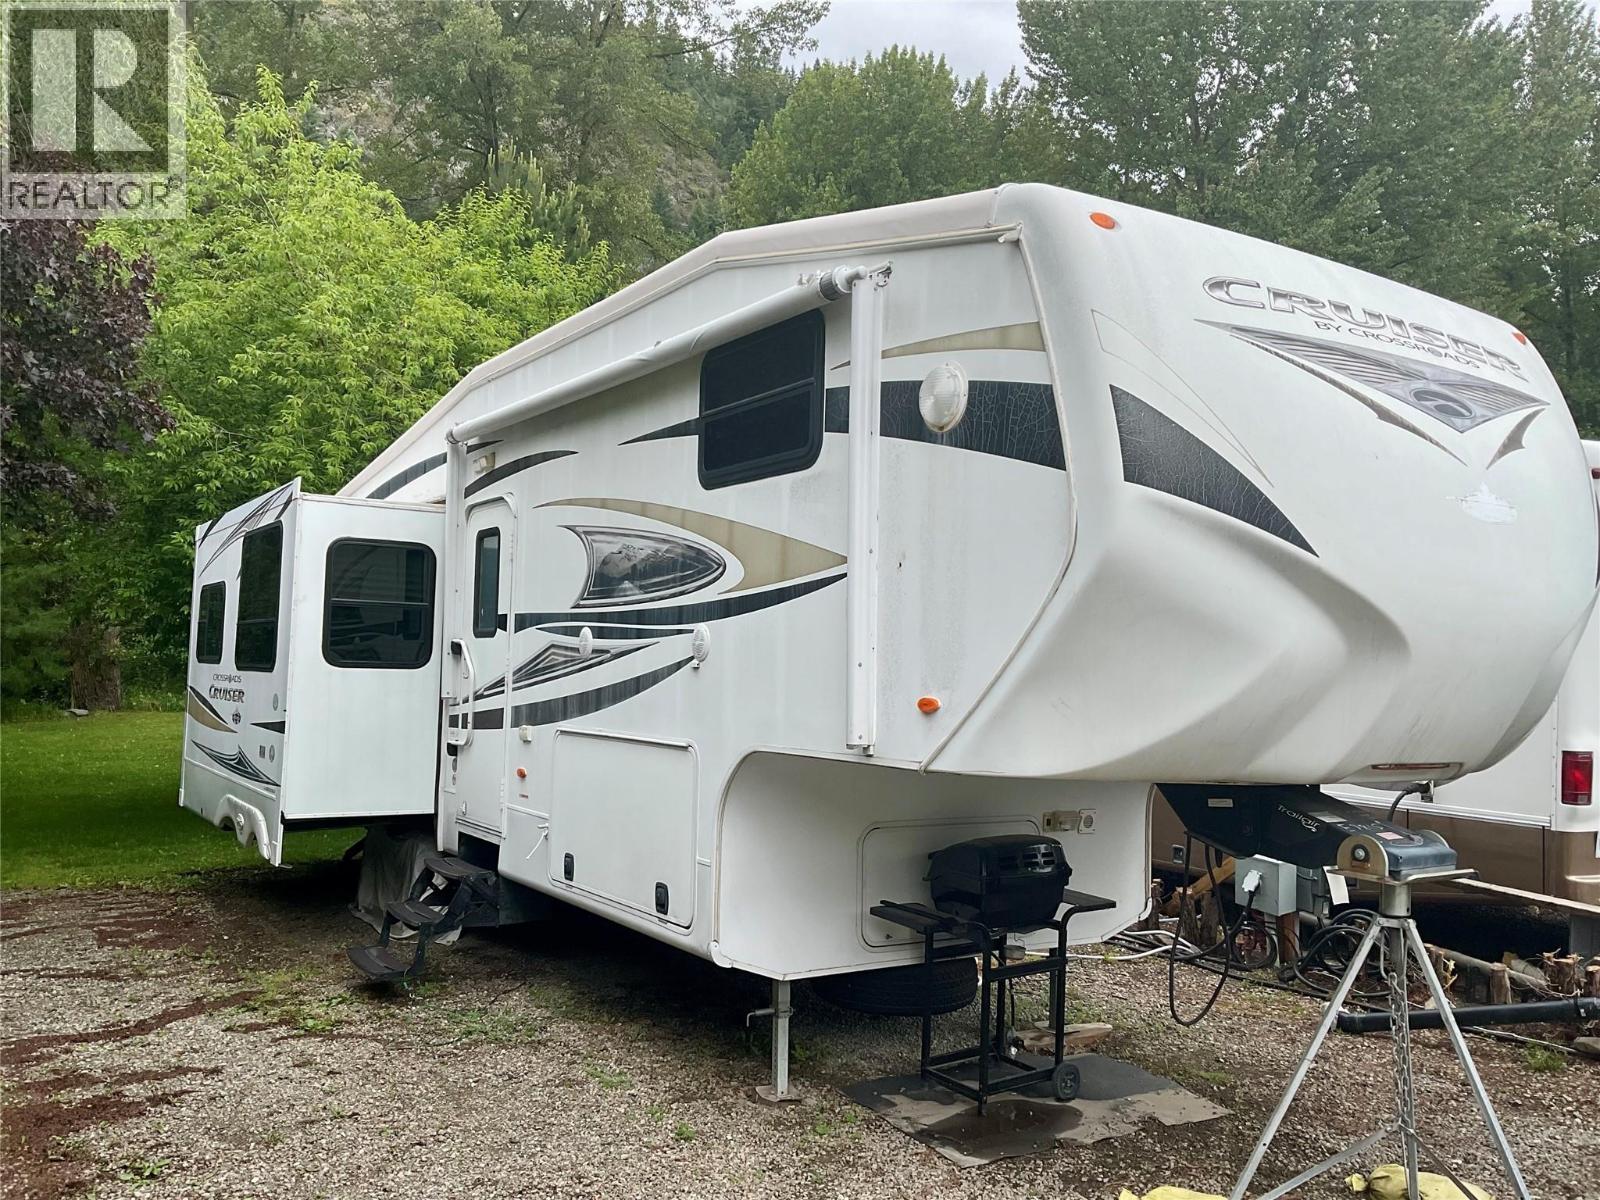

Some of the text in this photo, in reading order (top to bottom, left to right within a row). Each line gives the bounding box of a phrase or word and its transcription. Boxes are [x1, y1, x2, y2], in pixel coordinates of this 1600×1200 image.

[1203, 275, 1529, 382] CRUISER
[1314, 321, 1480, 369] BY CROSSROADS
